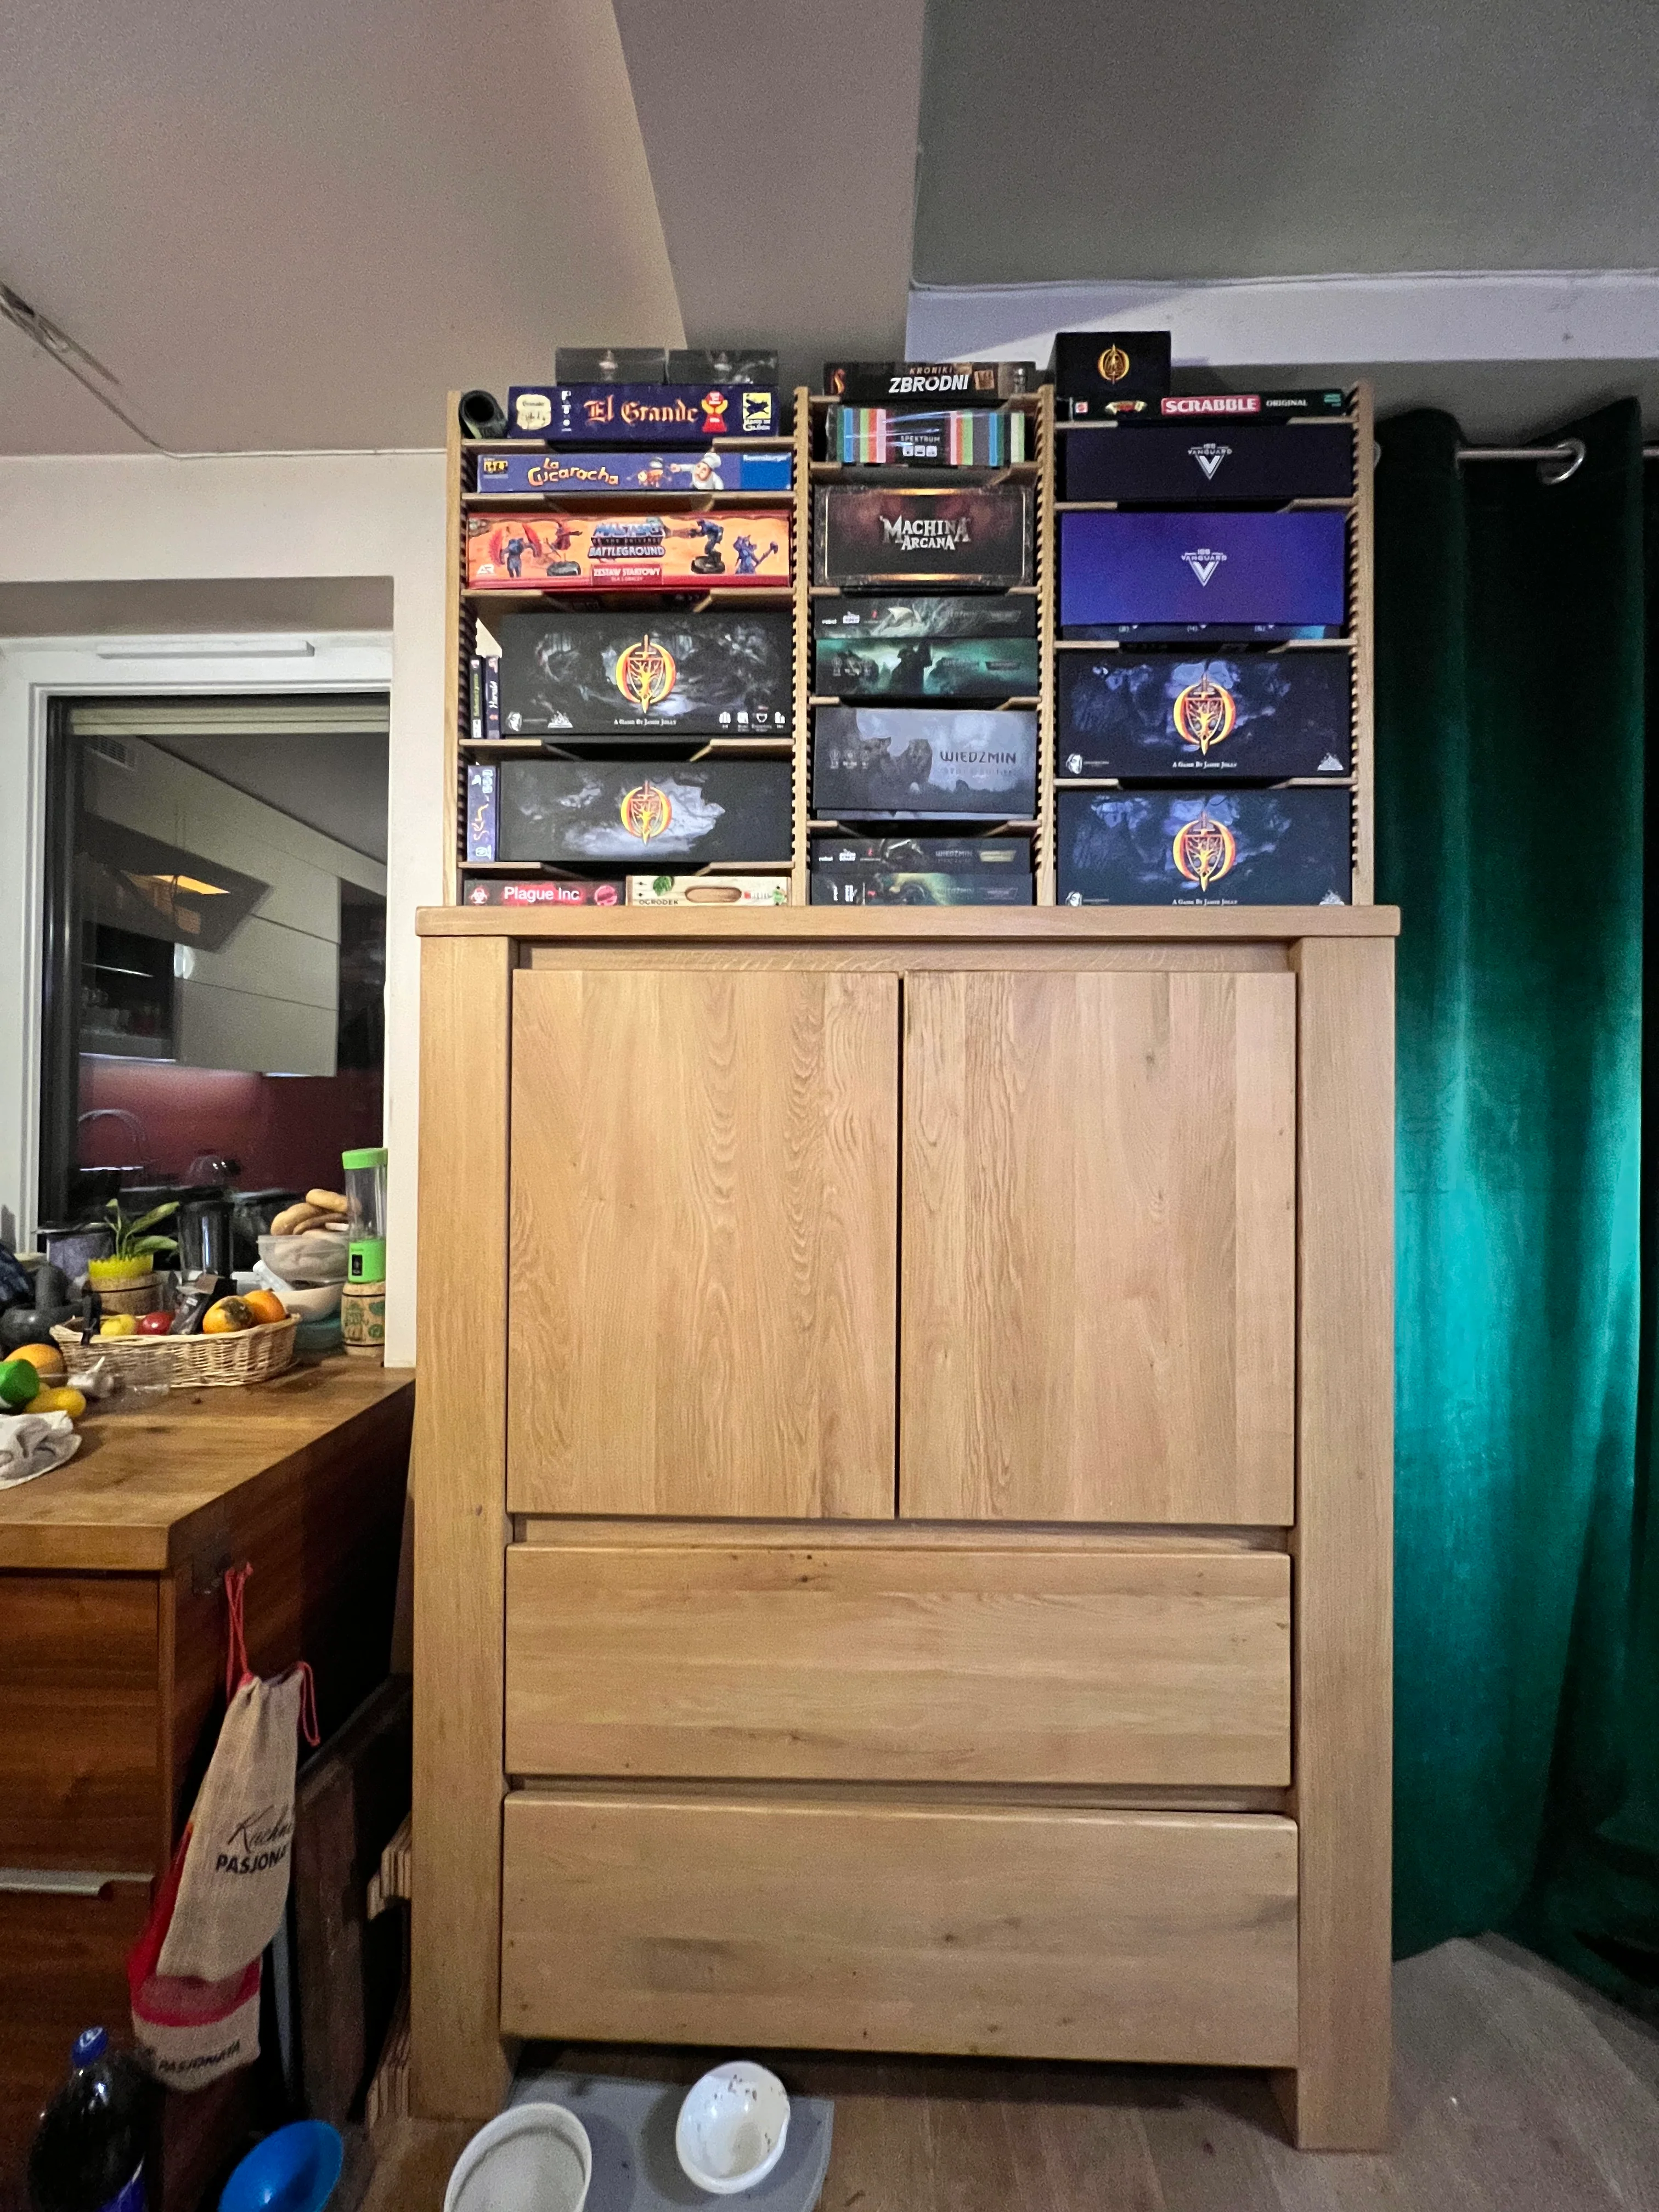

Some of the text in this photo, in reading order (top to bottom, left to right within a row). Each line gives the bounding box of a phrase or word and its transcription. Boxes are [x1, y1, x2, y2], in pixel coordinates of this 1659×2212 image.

[910, 365, 952, 375] KRONIKI
[889, 375, 969, 393] ZBRODNI
[584, 394, 614, 423] El
[621, 398, 698, 426] Grande
[1166, 398, 1257, 412] SCRABBLE
[543, 458, 560, 469] La
[528, 466, 619, 486] Cucaracha
[879, 515, 971, 544] MACHINA
[901, 535, 956, 550] ARCANA
[589, 546, 665, 556] BATTLEGROUND
[622, 568, 661, 576] STARTOWY
[504, 886, 580, 903] Plague Inc
[216, 1842, 289, 1874] PASJONA
